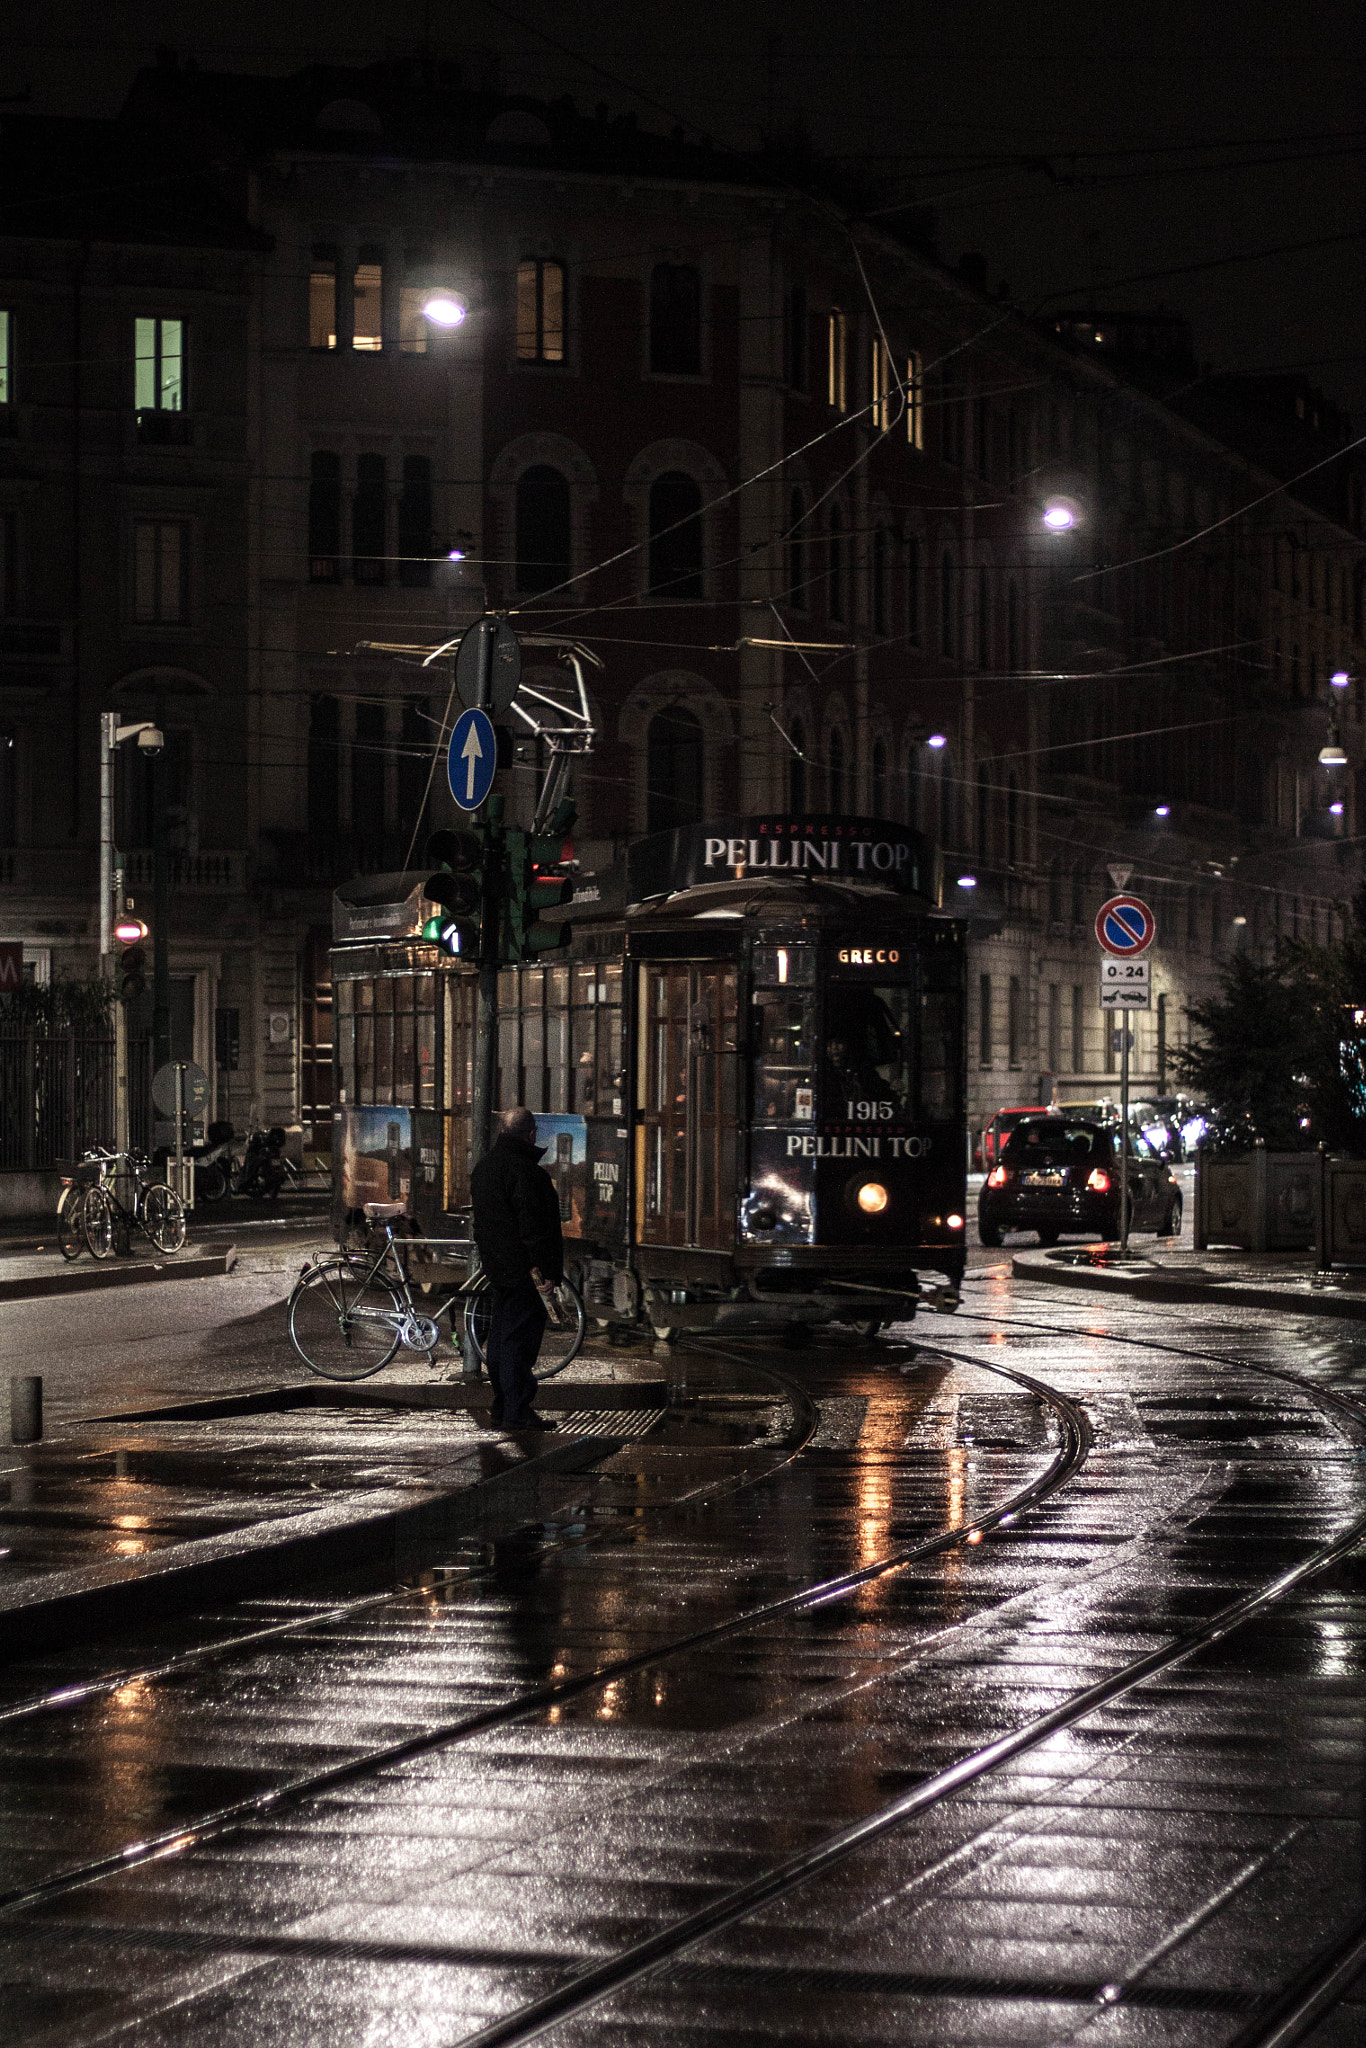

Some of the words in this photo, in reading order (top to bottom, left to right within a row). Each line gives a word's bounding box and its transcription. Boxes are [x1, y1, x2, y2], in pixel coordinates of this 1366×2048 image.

[759, 824, 872, 837] ESPRESSO
[704, 838, 840, 869] PELLINI
[850, 841, 910, 870] TOP
[838, 949, 900, 964] GRECO
[847, 1101, 894, 1121] 1915
[786, 1135, 880, 1158] PELLINI
[887, 1136, 932, 1159] TOP
[598, 1183, 614, 1202] TOP
